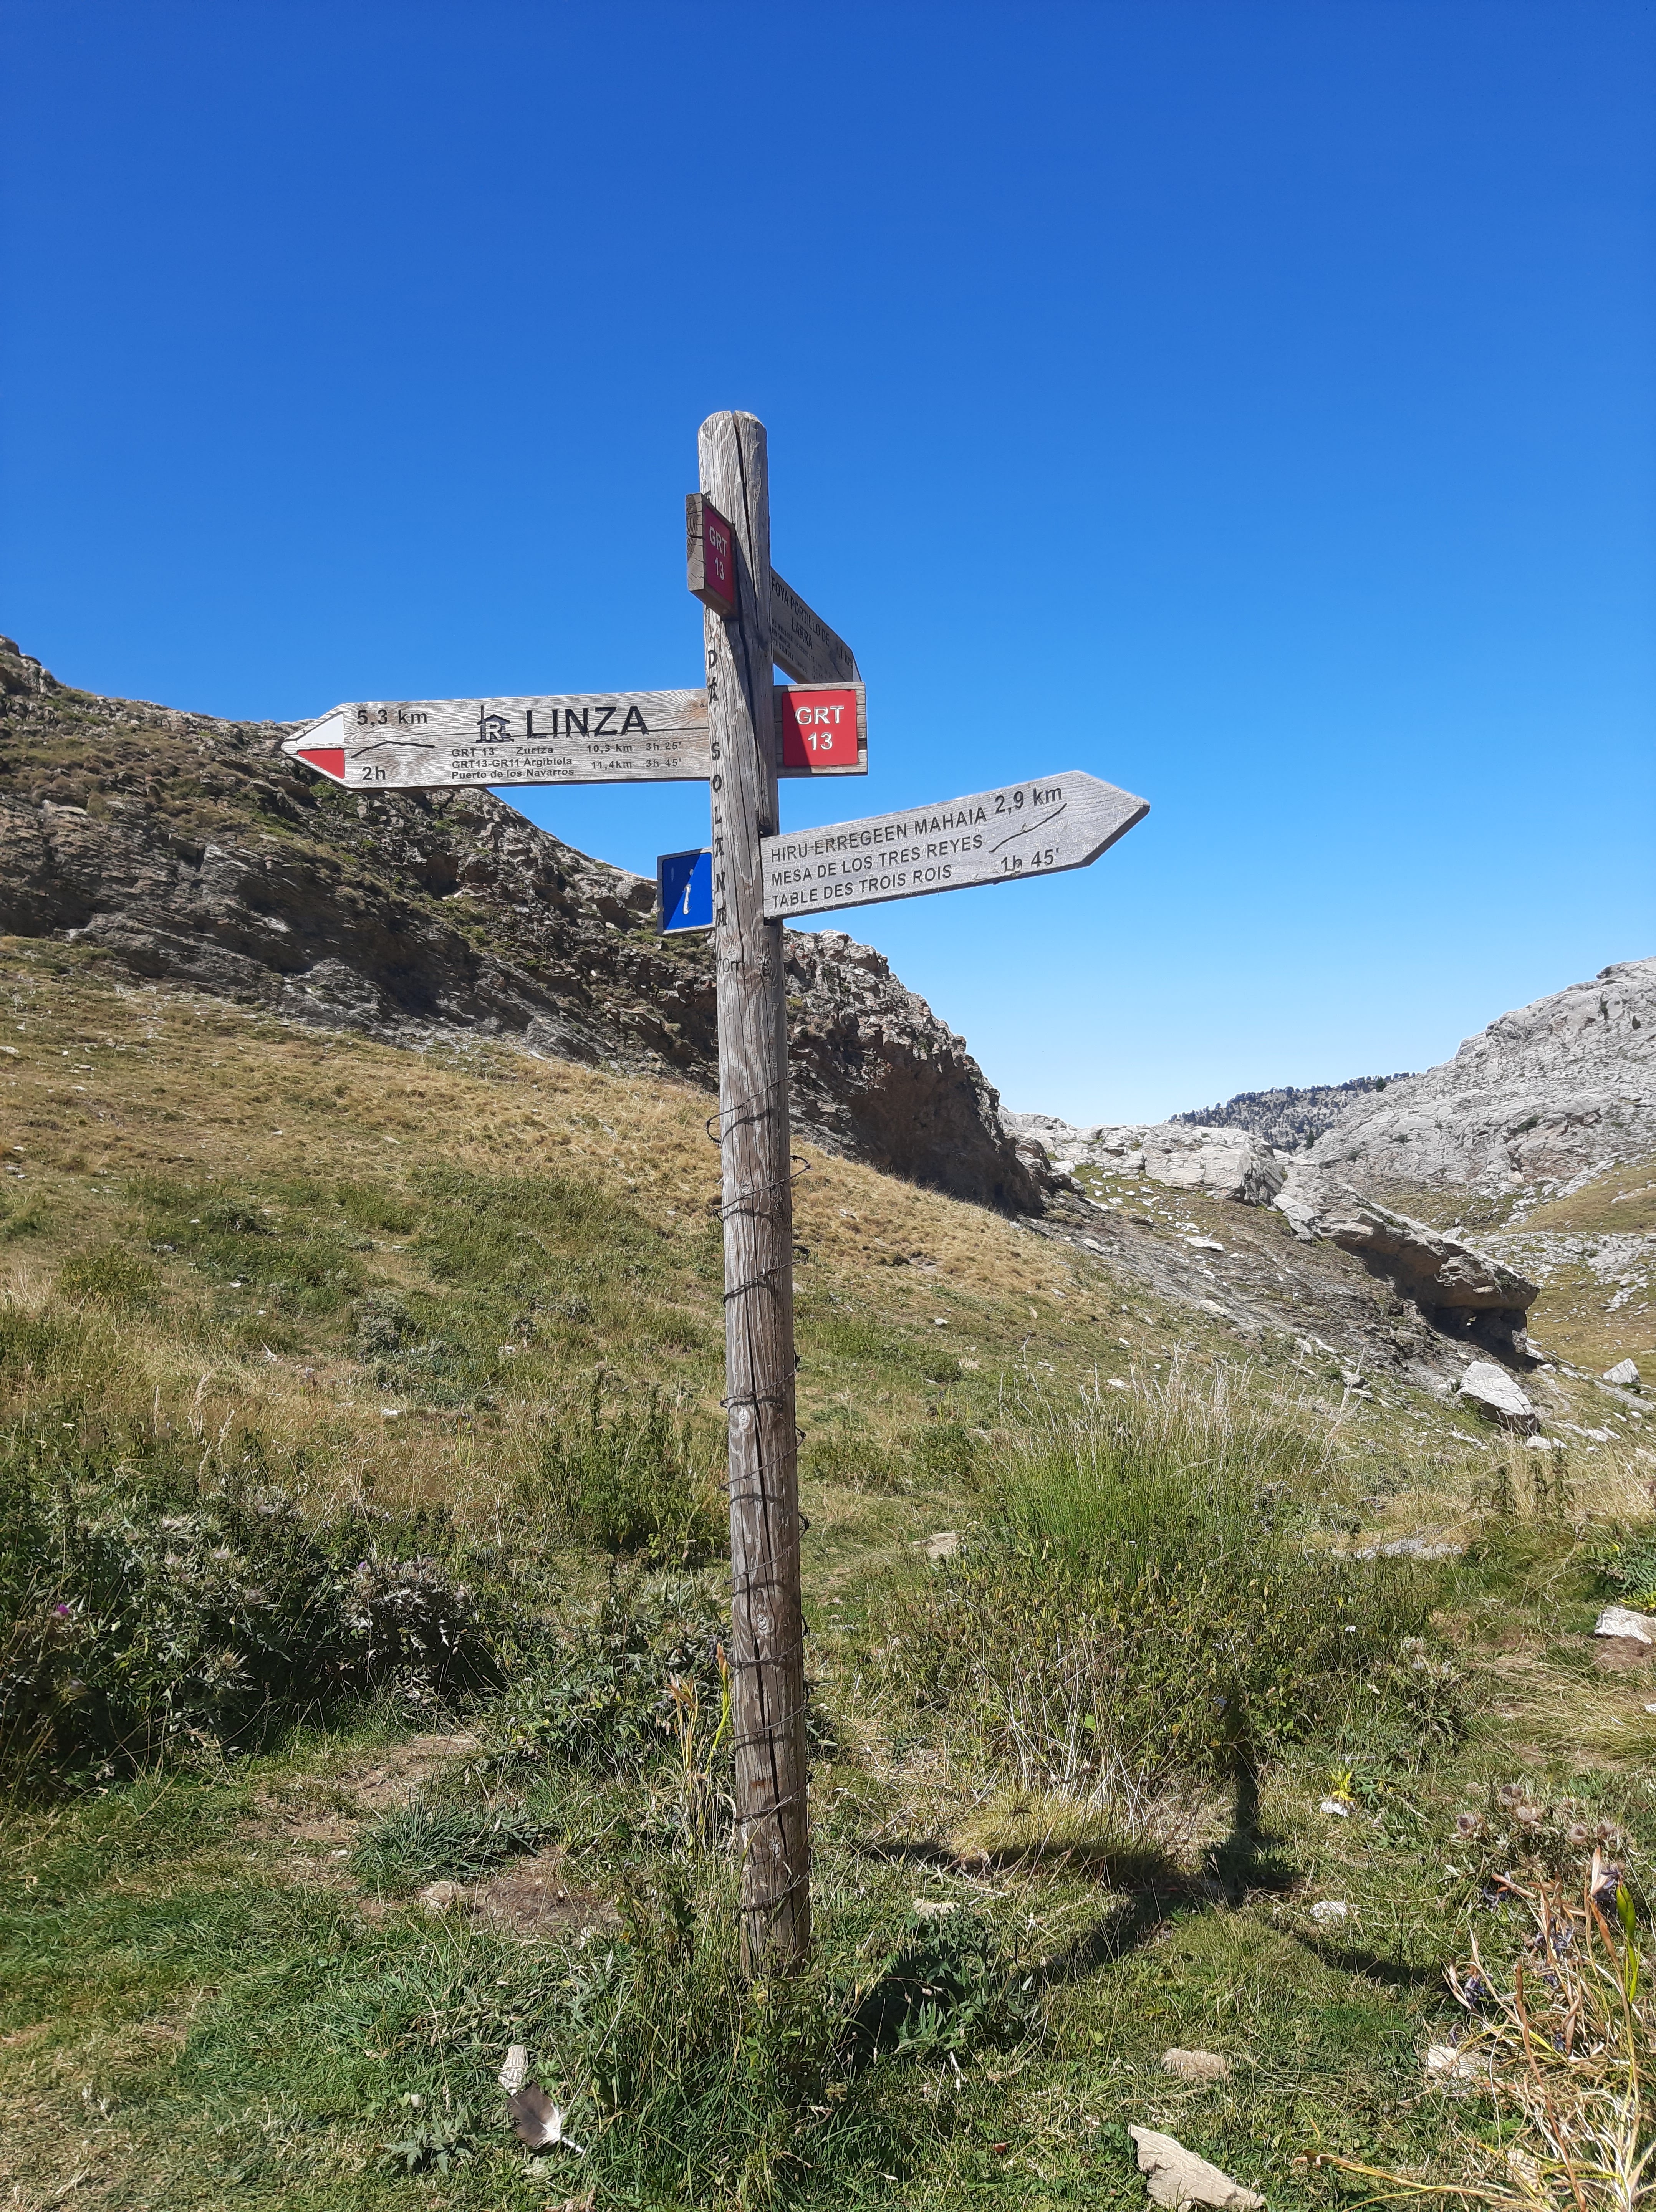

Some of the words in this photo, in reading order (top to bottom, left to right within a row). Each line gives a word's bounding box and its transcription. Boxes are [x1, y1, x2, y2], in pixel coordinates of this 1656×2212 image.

[709, 526, 727, 557] GRT
[715, 557, 724, 580] 13
[790, 596, 820, 636] PORTILLO
[792, 617, 813, 650] LARRA
[357, 709, 388, 728] 5,3
[398, 710, 427, 724] km
[526, 706, 650, 739] LINZA
[795, 705, 845, 725] GRT
[452, 748, 476, 757] GRT
[482, 747, 495, 756] 13
[516, 747, 553, 755] Zuriza
[587, 744, 610, 754] 10,3
[646, 743, 659, 751] 3h
[665, 741, 682, 750] 25'
[808, 732, 833, 750] 13
[362, 767, 386, 781] 2h
[452, 758, 519, 768] GRT13-GR11
[523, 757, 572, 767] Argibiela
[646, 759, 659, 767] 3h
[665, 758, 682, 767] 45'
[452, 771, 486, 779] Puerto
[527, 768, 574, 777] Navarros
[772, 843, 808, 863] HIRU
[815, 823, 907, 855] ERREGEEN
[915, 808, 987, 836] MAHAIA
[995, 791, 1024, 815] 2,9
[1033, 787, 1062, 806] km
[772, 868, 812, 886] MESA
[818, 863, 836, 878] DE
[842, 856, 873, 873] LOS
[879, 847, 920, 867] TRES
[927, 834, 982, 858] REYES
[1001, 855, 1022, 873] 1h
[1031, 848, 1059, 868] 45'
[772, 889, 818, 909] TABLE
[824, 883, 853, 899] DES
[859, 873, 906, 893] TROIS
[913, 864, 952, 884] ROIS
